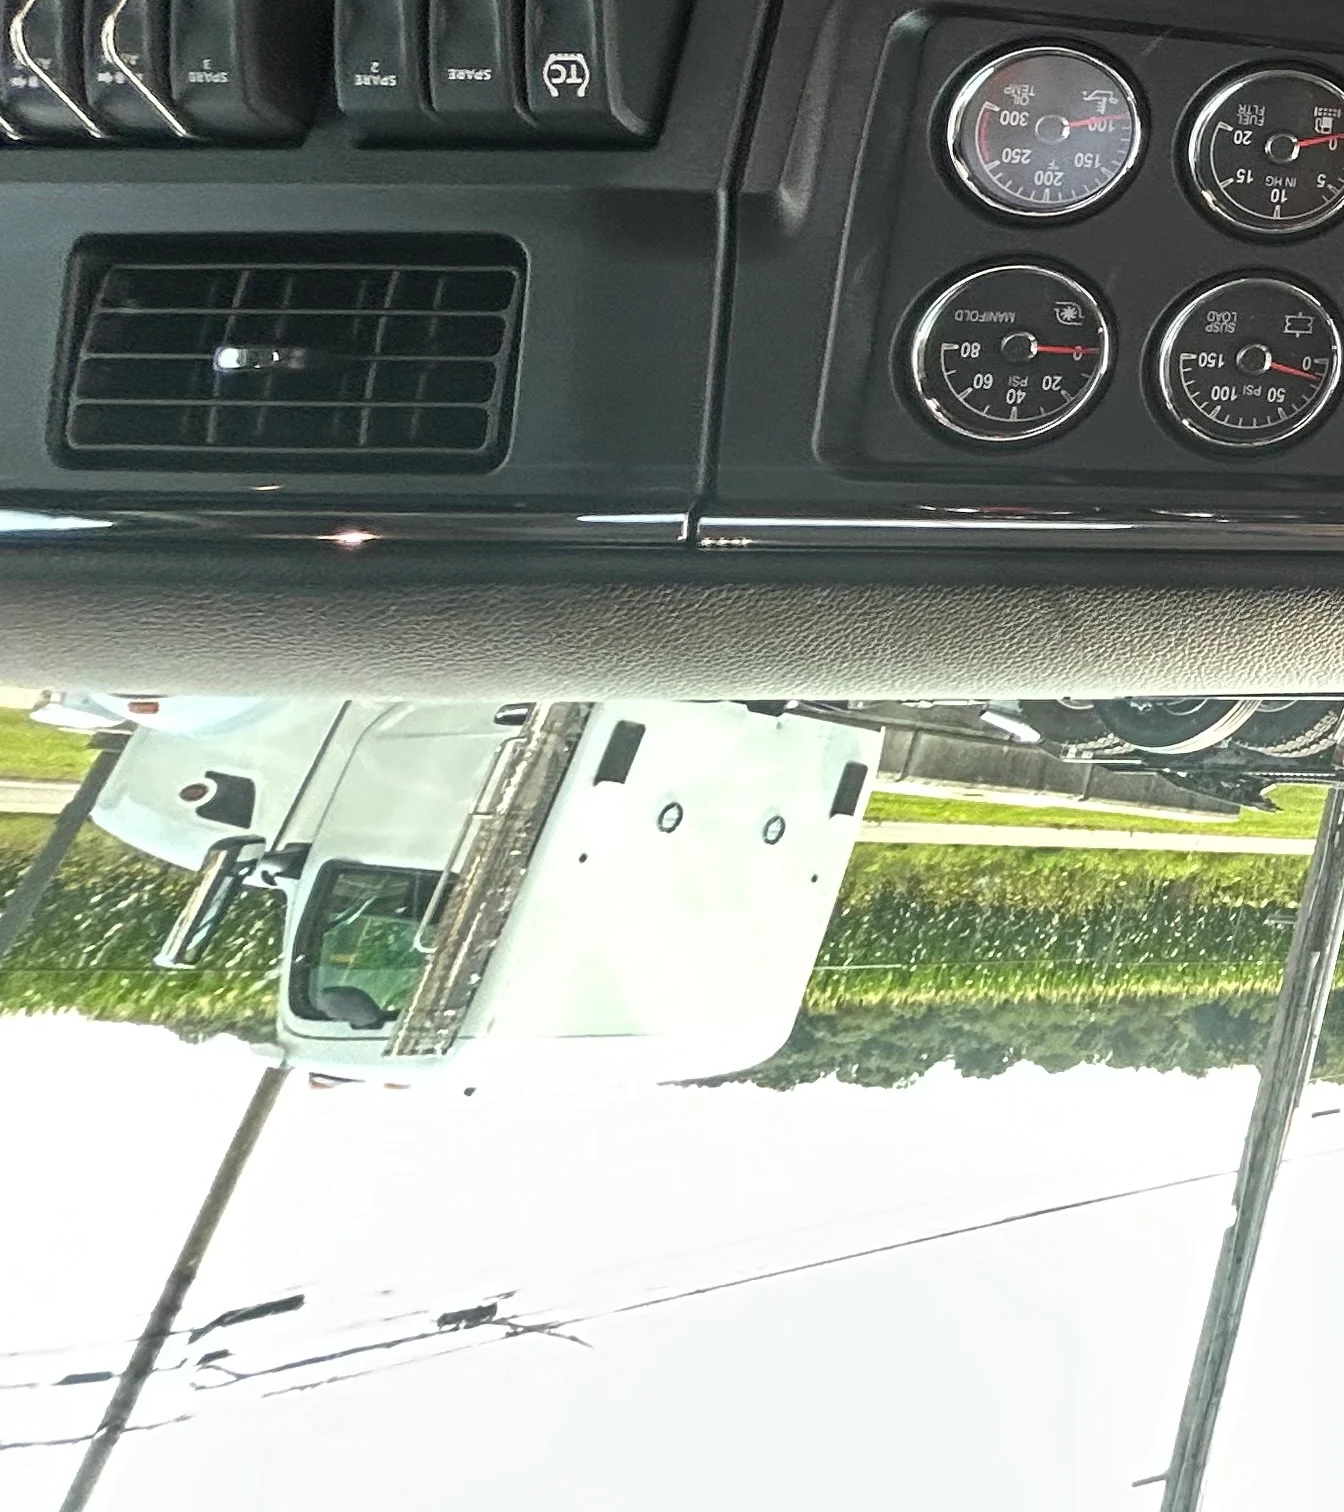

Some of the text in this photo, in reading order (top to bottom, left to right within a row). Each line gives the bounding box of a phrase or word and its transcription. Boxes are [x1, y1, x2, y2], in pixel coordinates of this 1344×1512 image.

[202, 58, 211, 70] 3
[370, 61, 379, 73] 2
[188, 71, 229, 83] SPARE
[354, 74, 397, 86] SPARE
[447, 68, 492, 81] SPARE
[1003, 83, 1035, 96] TEMP
[1012, 94, 1030, 105] OIL
[1237, 103, 1266, 116] FLTR
[999, 110, 1029, 126] 300
[1236, 114, 1265, 127] FUEL
[1233, 129, 1252, 145] 20
[1002, 147, 1032, 164] 250
[1074, 152, 1101, 168] 150
[1034, 170, 1064, 186] 200
[1236, 168, 1254, 183] 15
[1265, 175, 1296, 186] IN HG
[1316, 173, 1326, 188] 5
[1270, 188, 1288, 203] 10
[954, 309, 1016, 324] MANIFOLD
[1207, 311, 1238, 322] LOAD
[1205, 322, 1236, 334] SUSP
[960, 342, 981, 358] 80
[1198, 352, 1225, 368] 150
[1302, 356, 1312, 371] 0
[973, 373, 993, 389] 60
[1008, 375, 1029, 387] PSI
[1042, 375, 1062, 390] 20
[1006, 388, 1026, 405] 40
[1211, 385, 1238, 401] 100
[1243, 385, 1262, 396] PSI
[1267, 387, 1286, 403] 50
